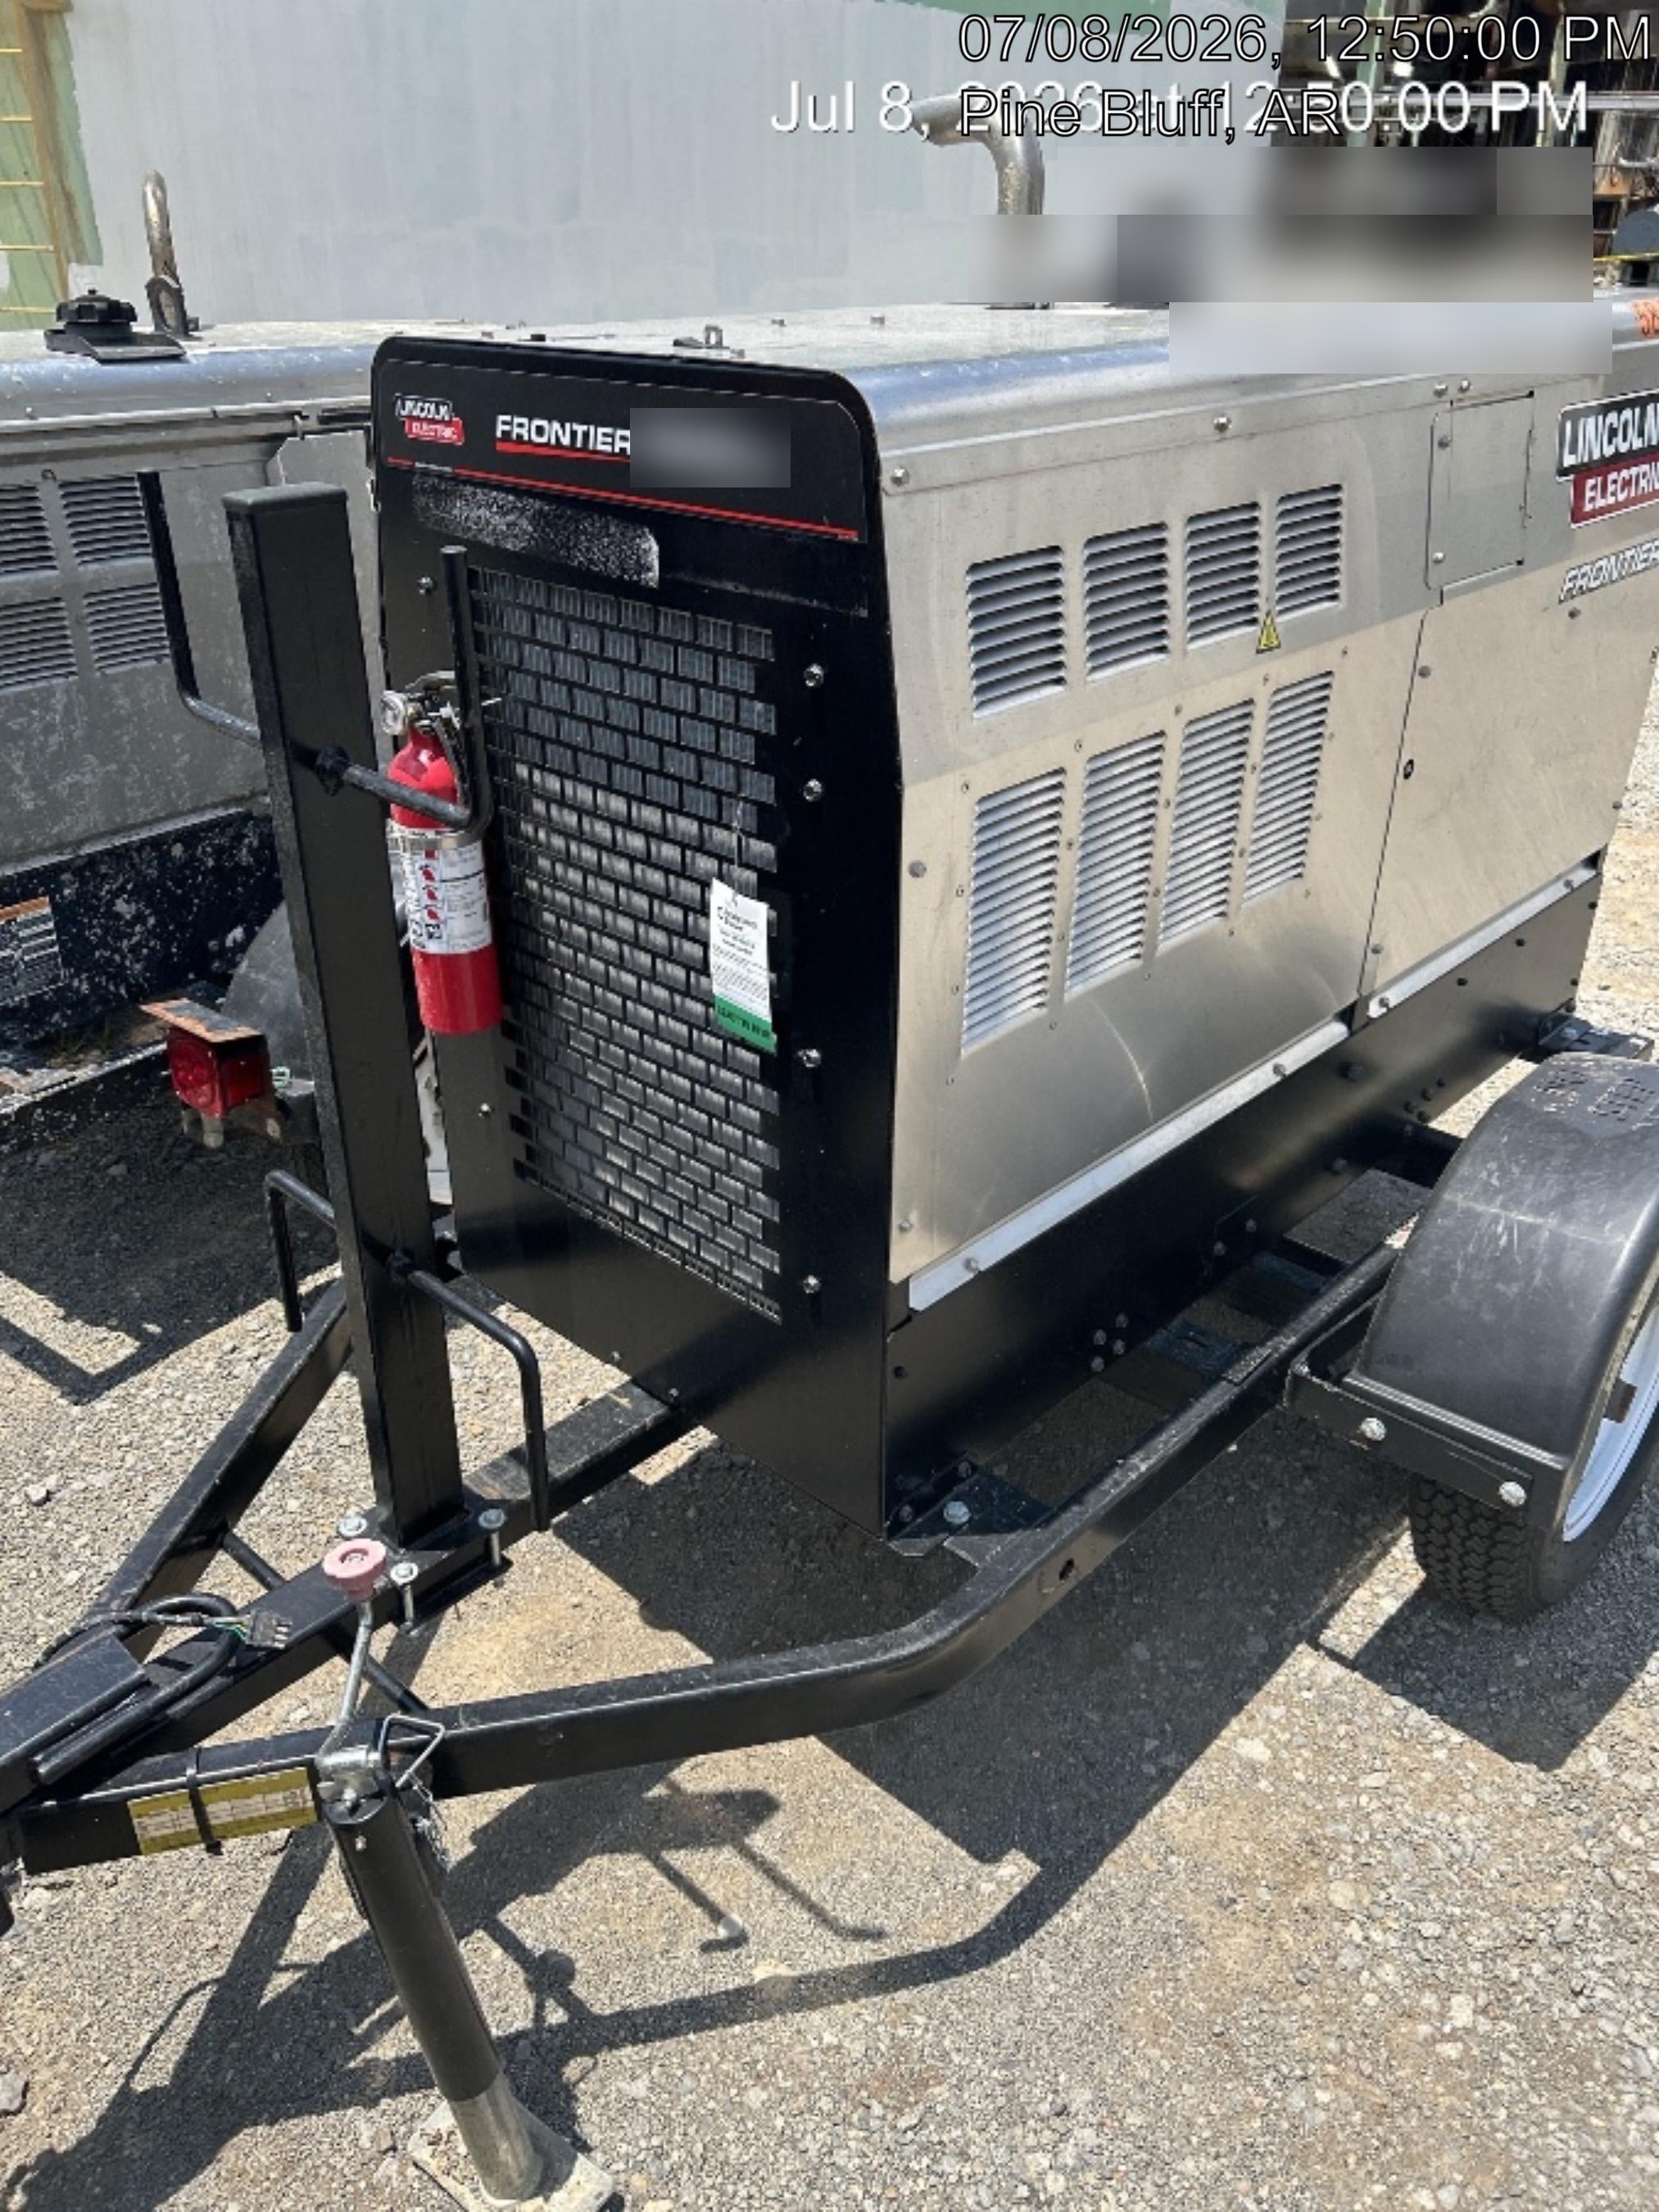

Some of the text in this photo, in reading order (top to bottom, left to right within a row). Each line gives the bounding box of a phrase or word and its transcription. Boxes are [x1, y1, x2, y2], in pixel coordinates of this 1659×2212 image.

[395, 398, 451, 421] LINCOLN
[496, 414, 631, 456] FRONTIER
[1562, 402, 1659, 468] LINCOLN
